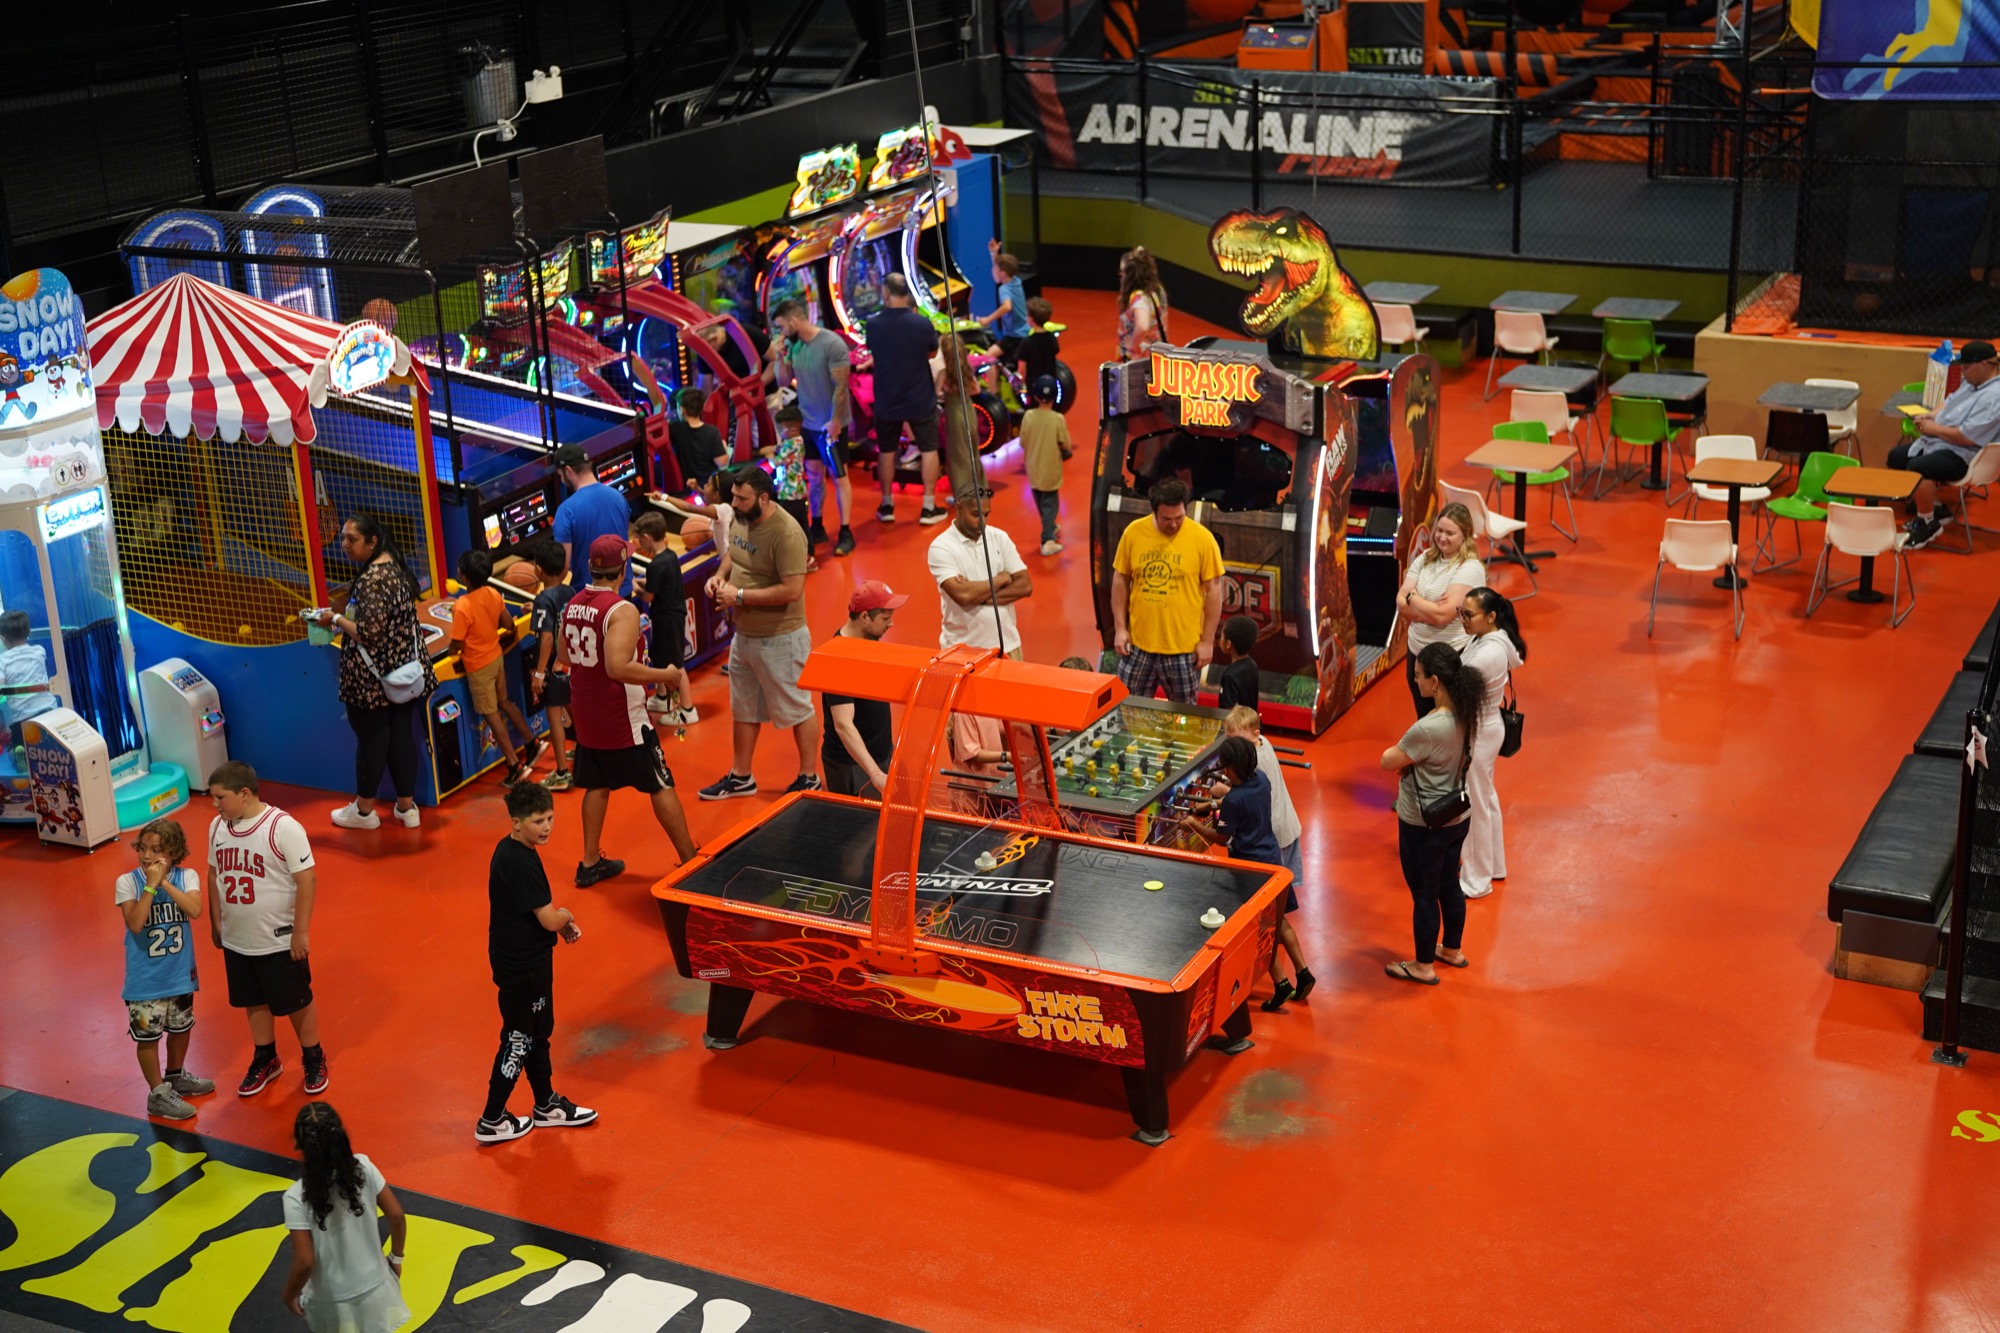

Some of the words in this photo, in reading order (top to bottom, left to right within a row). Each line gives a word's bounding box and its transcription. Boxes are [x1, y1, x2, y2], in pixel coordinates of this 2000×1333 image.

[1077, 103, 1402, 161] ADRENALINE
[0, 287, 73, 334] SNOW
[18, 317, 77, 361] DAY!
[1147, 352, 1261, 402] JURASSIC
[1180, 396, 1231, 427] PARK
[536, 609, 546, 628] 7
[567, 604, 599, 623] BRYANT
[565, 623, 599, 668] 33
[28, 747, 73, 766] SNOW
[38, 761, 70, 780] DAY!
[216, 848, 265, 878] BULLS
[224, 876, 256, 905] 23
[148, 924, 184, 958] 23
[700, 969, 728, 977] DYNAMO
[1025, 987, 1104, 1022] FIRE
[1016, 1014, 1128, 1049] STORM
